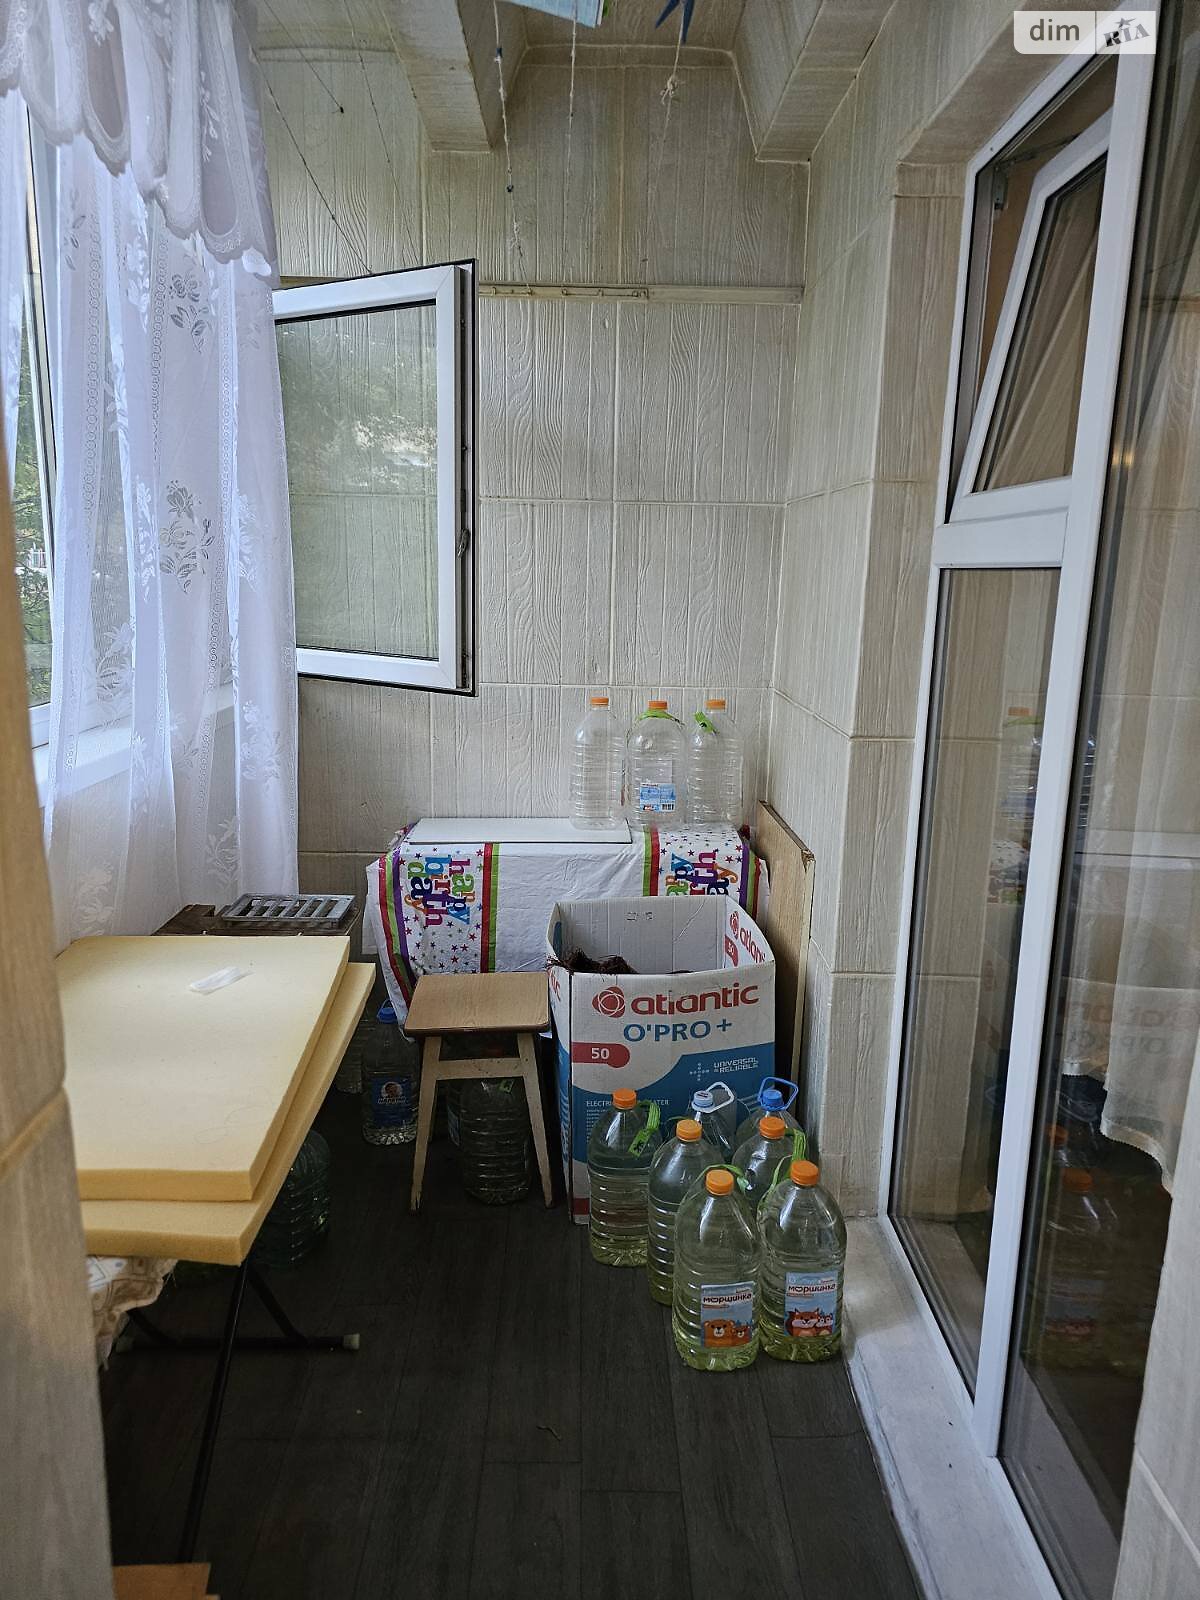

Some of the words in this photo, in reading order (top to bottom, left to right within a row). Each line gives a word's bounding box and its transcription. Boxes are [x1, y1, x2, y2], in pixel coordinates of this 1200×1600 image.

[404, 861, 433, 916] day
[424, 854, 457, 926] birth
[448, 858, 475, 925] happy
[623, 1020, 711, 1042] O'PRO
[591, 1047, 610, 1060] 50
[713, 1057, 757, 1069] UNIVERSAL
